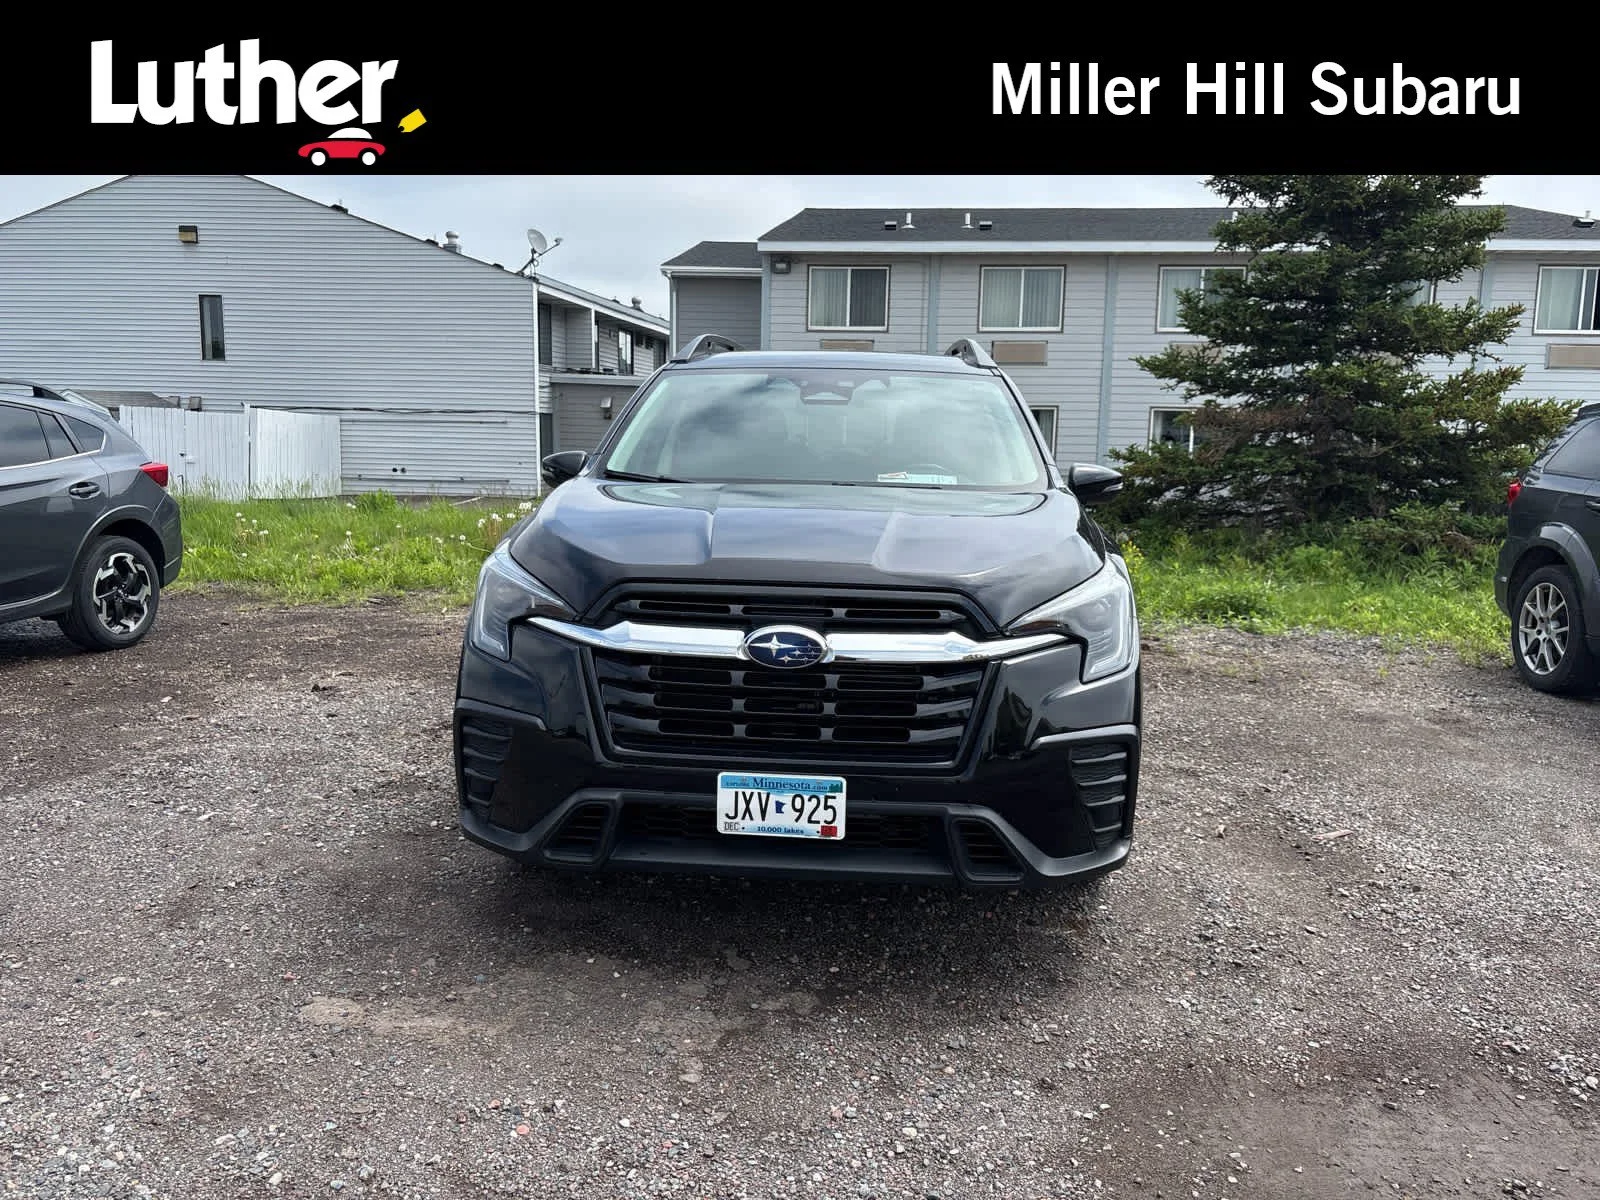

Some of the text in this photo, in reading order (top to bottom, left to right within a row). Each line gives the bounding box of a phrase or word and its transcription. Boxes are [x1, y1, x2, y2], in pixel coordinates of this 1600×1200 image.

[753, 776, 811, 790] Minnesota
[725, 791, 837, 825] JXV 925
